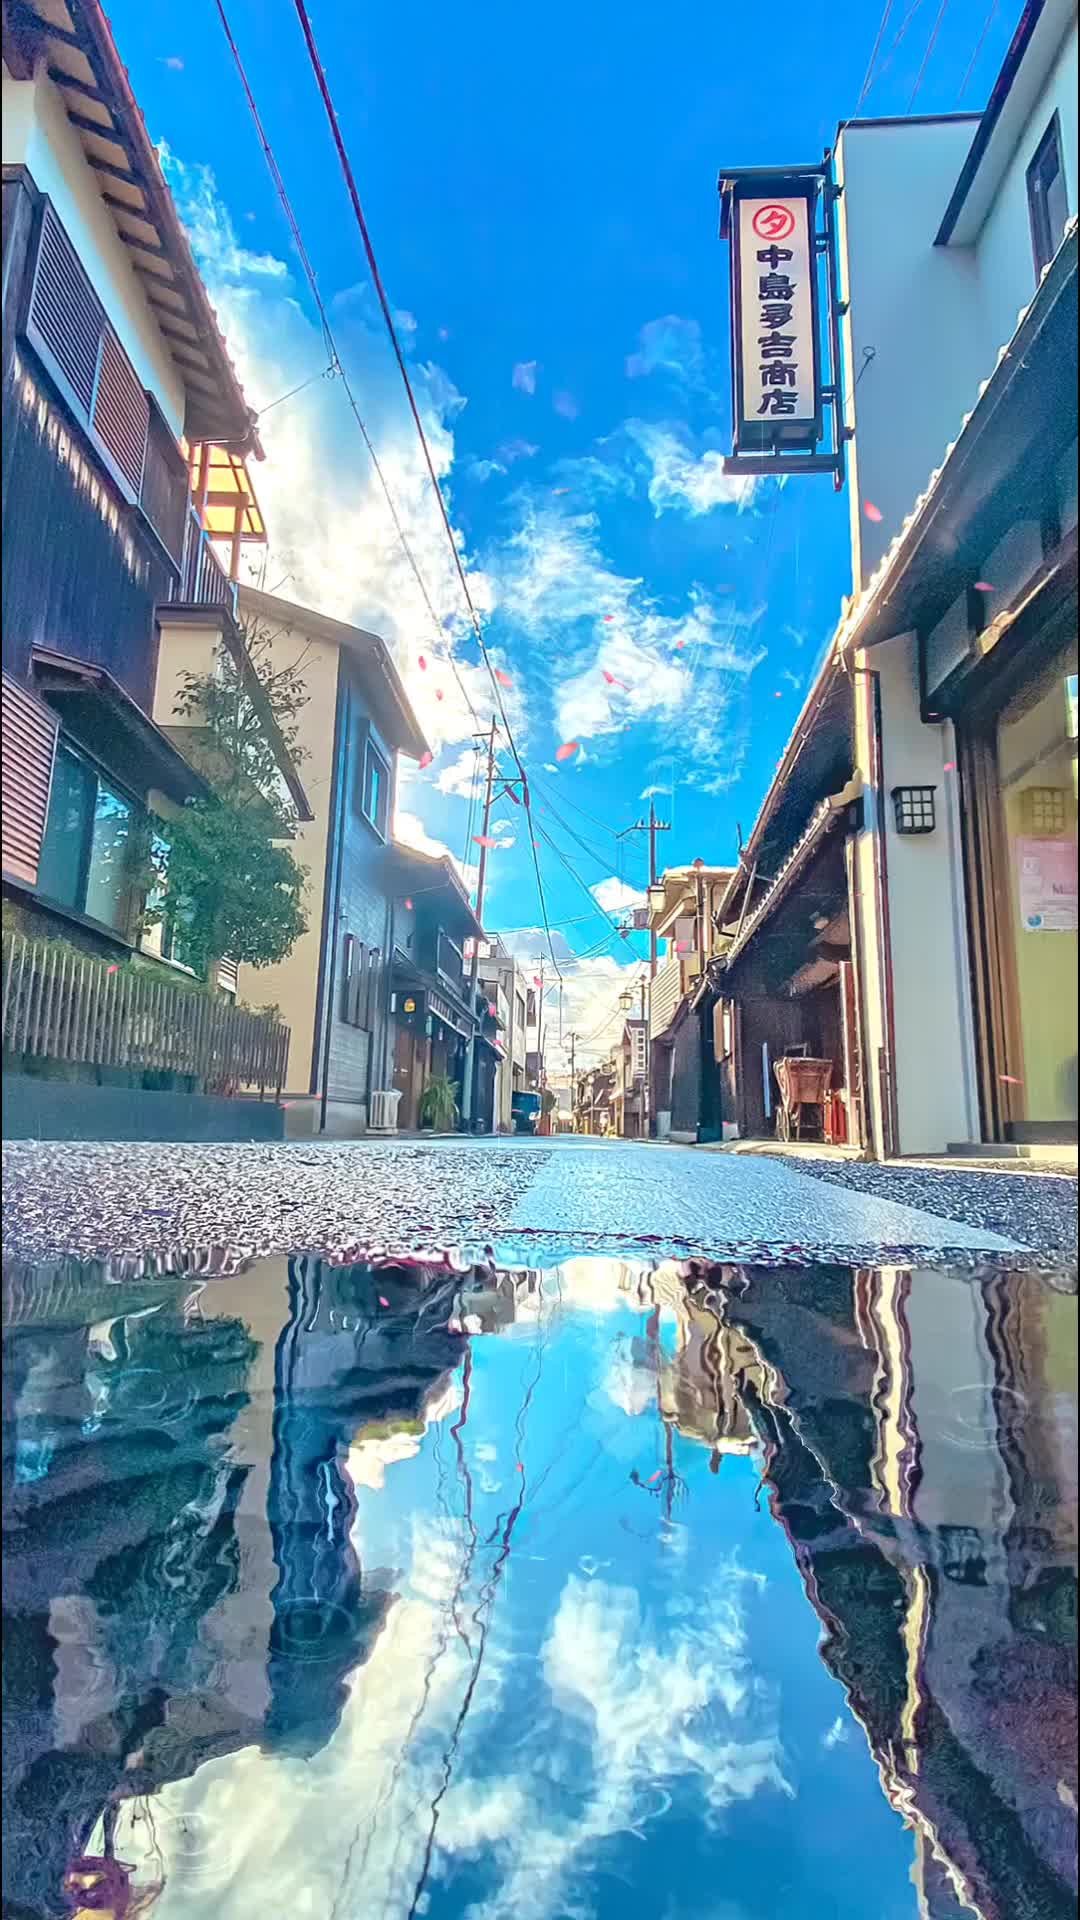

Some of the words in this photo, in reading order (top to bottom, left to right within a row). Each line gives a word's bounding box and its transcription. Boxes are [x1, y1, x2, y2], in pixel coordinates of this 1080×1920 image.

[756, 244, 799, 415] 中島多吉商店
